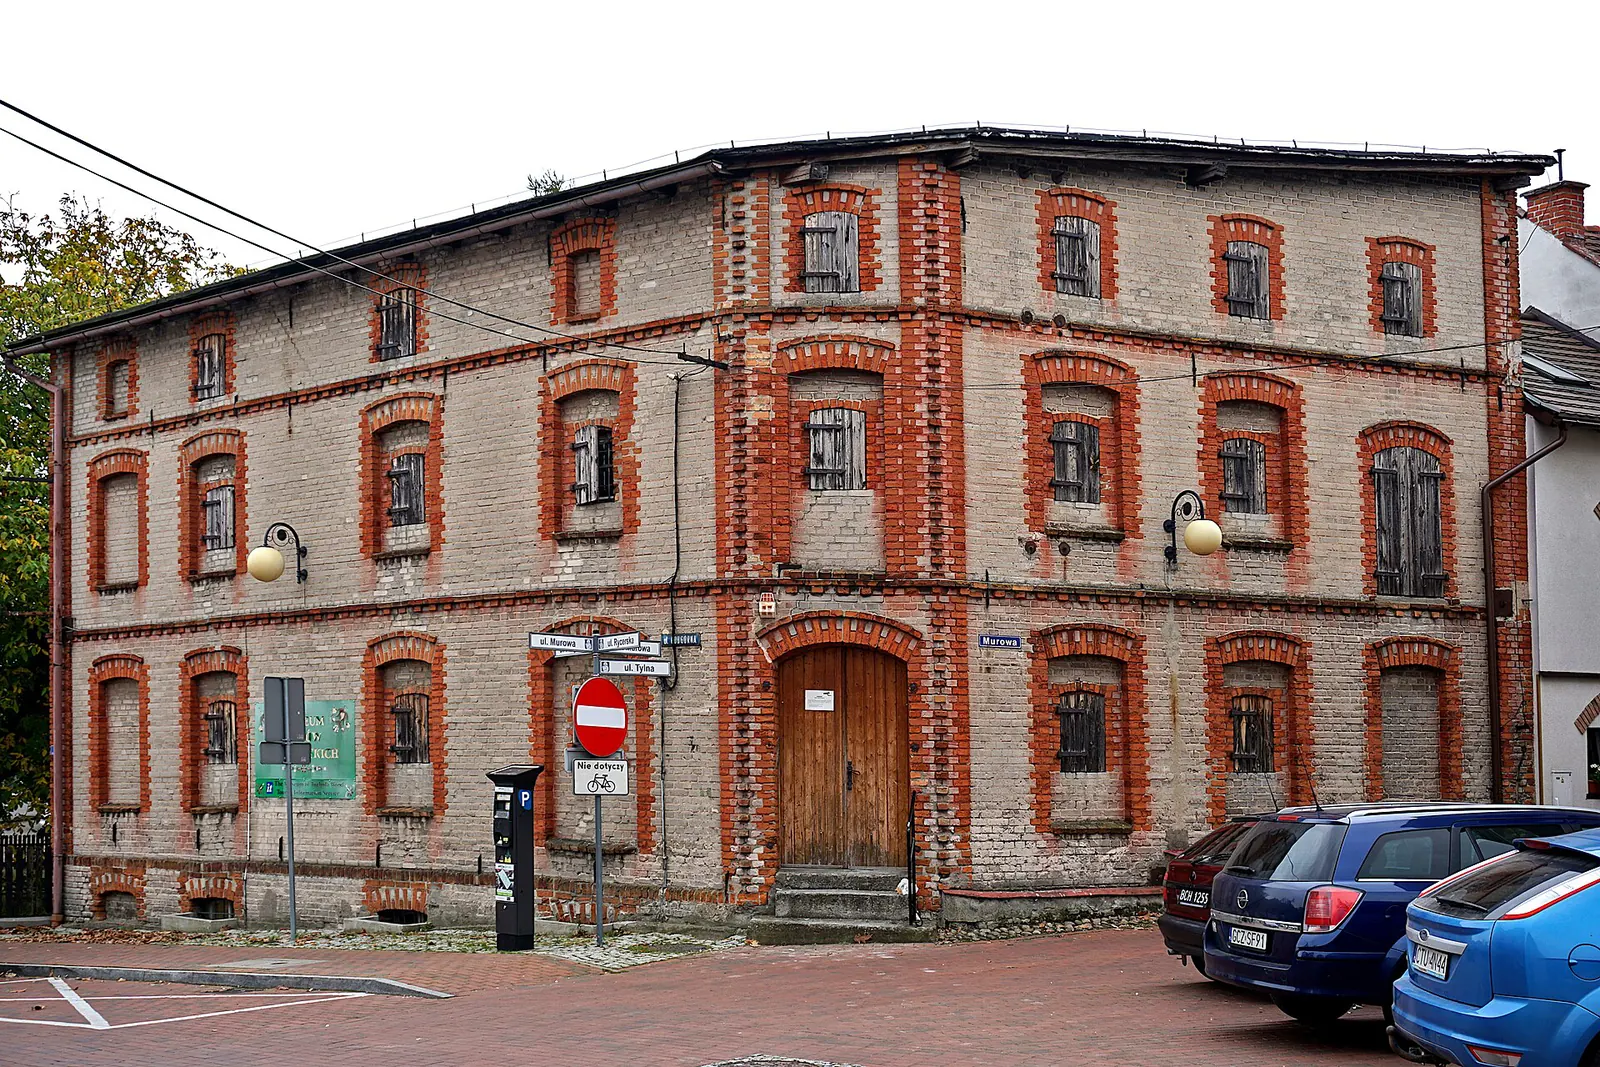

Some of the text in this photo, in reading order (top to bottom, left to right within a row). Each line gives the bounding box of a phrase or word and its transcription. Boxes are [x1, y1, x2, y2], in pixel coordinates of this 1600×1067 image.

[540, 637, 576, 648] ul. Murowa
[982, 636, 1018, 646] Murowa
[624, 663, 655, 674] ul. Tylna
[577, 761, 624, 772] Nie dotyczy
[521, 791, 530, 807] P
[1193, 891, 1209, 905] 1255
[1232, 929, 1265, 949] GCZ SF91
[1416, 946, 1430, 966] CTU
